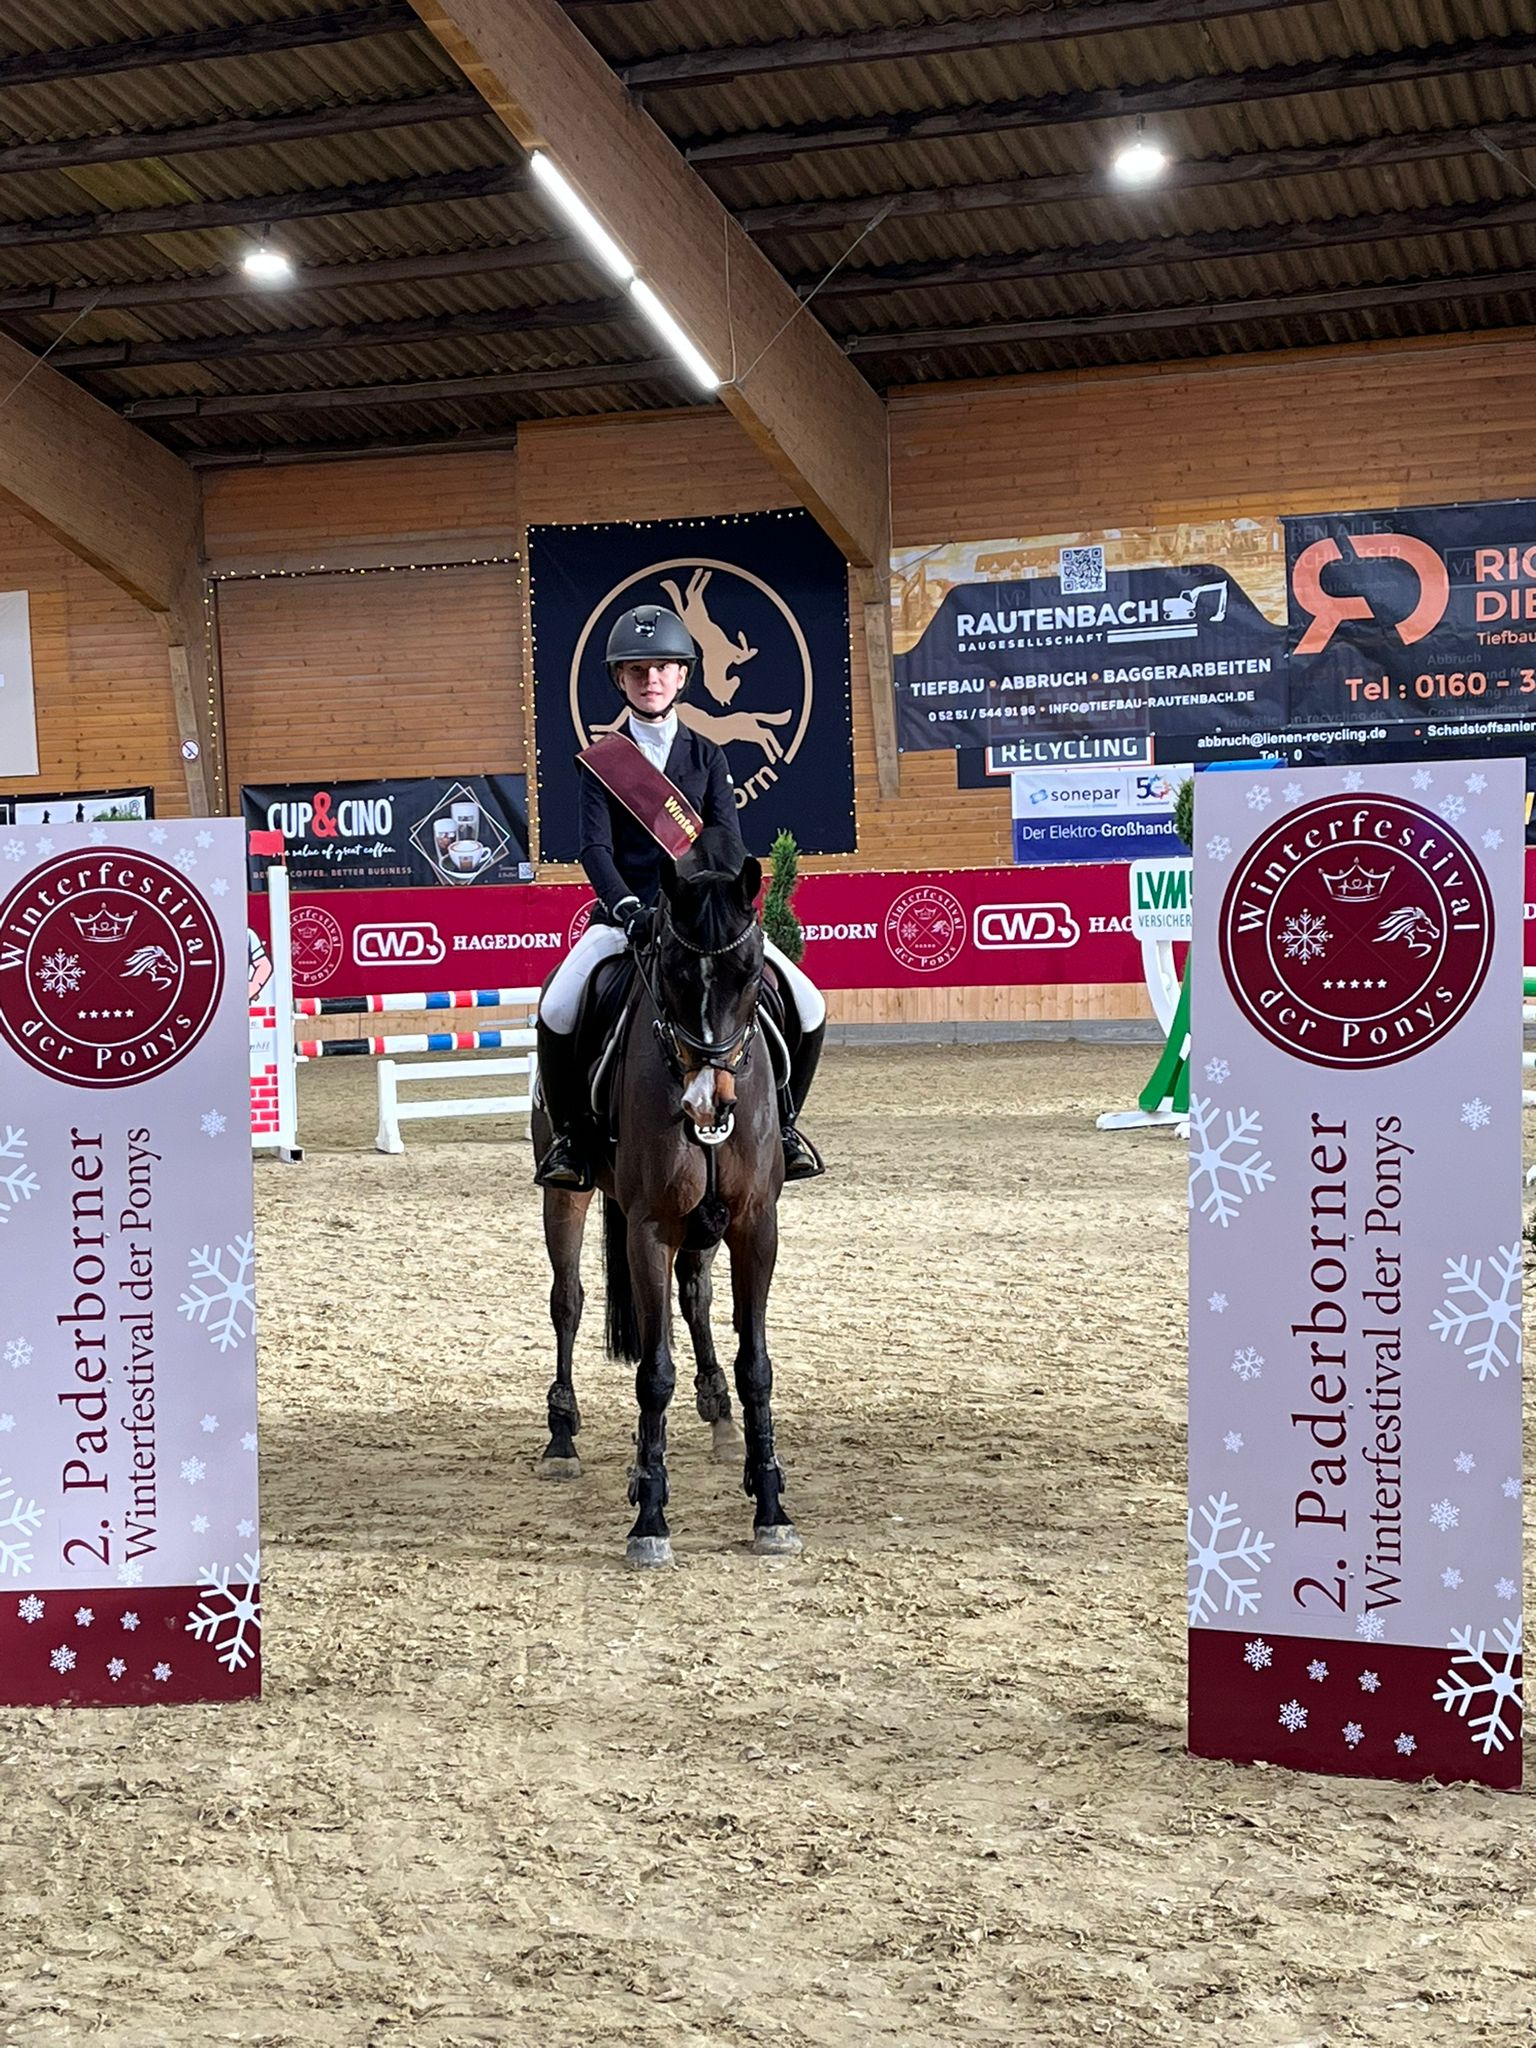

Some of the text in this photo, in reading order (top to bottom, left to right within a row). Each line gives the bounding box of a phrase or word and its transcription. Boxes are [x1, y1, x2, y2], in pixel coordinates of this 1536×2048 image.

[957, 600, 1160, 637] RAUTENBACH
[958, 632, 1103, 652] BAUGESELLSCHAFT
[910, 657, 1272, 697] TIEFBAU ABBRUCH BAGGERARBEITEN
[1345, 676, 1390, 701] Tel
[1415, 671, 1487, 698] 0160
[1048, 690, 1256, 715] INFO@TIEFBAU-RAUTENBACH.DE
[1001, 736, 1138, 763] RECYCLING
[1197, 727, 1387, 748] abbruch@lienen-recycling.de
[1051, 786, 1121, 803] sonepar
[1022, 825, 1046, 840] Der
[1237, 810, 1481, 933] Winterfestival
[0, 861, 213, 971] Winterfestival
[887, 888, 964, 931] Winterfestival
[982, 911, 1056, 941] CWD
[360, 930, 425, 958] CWD
[453, 932, 563, 951] HAGEDORN
[894, 945, 957, 968] der Ponys
[1260, 986, 1454, 1048] der Ponys
[21, 1014, 192, 1070] der Ponys
[57, 1127, 110, 1567] 2. Paderborner
[119, 1126, 162, 1563] Winterfestival der Ponys
[1290, 1111, 1348, 1613] 2. Paderborner
[1362, 1114, 1414, 1612] Winterfestival der Ponys
